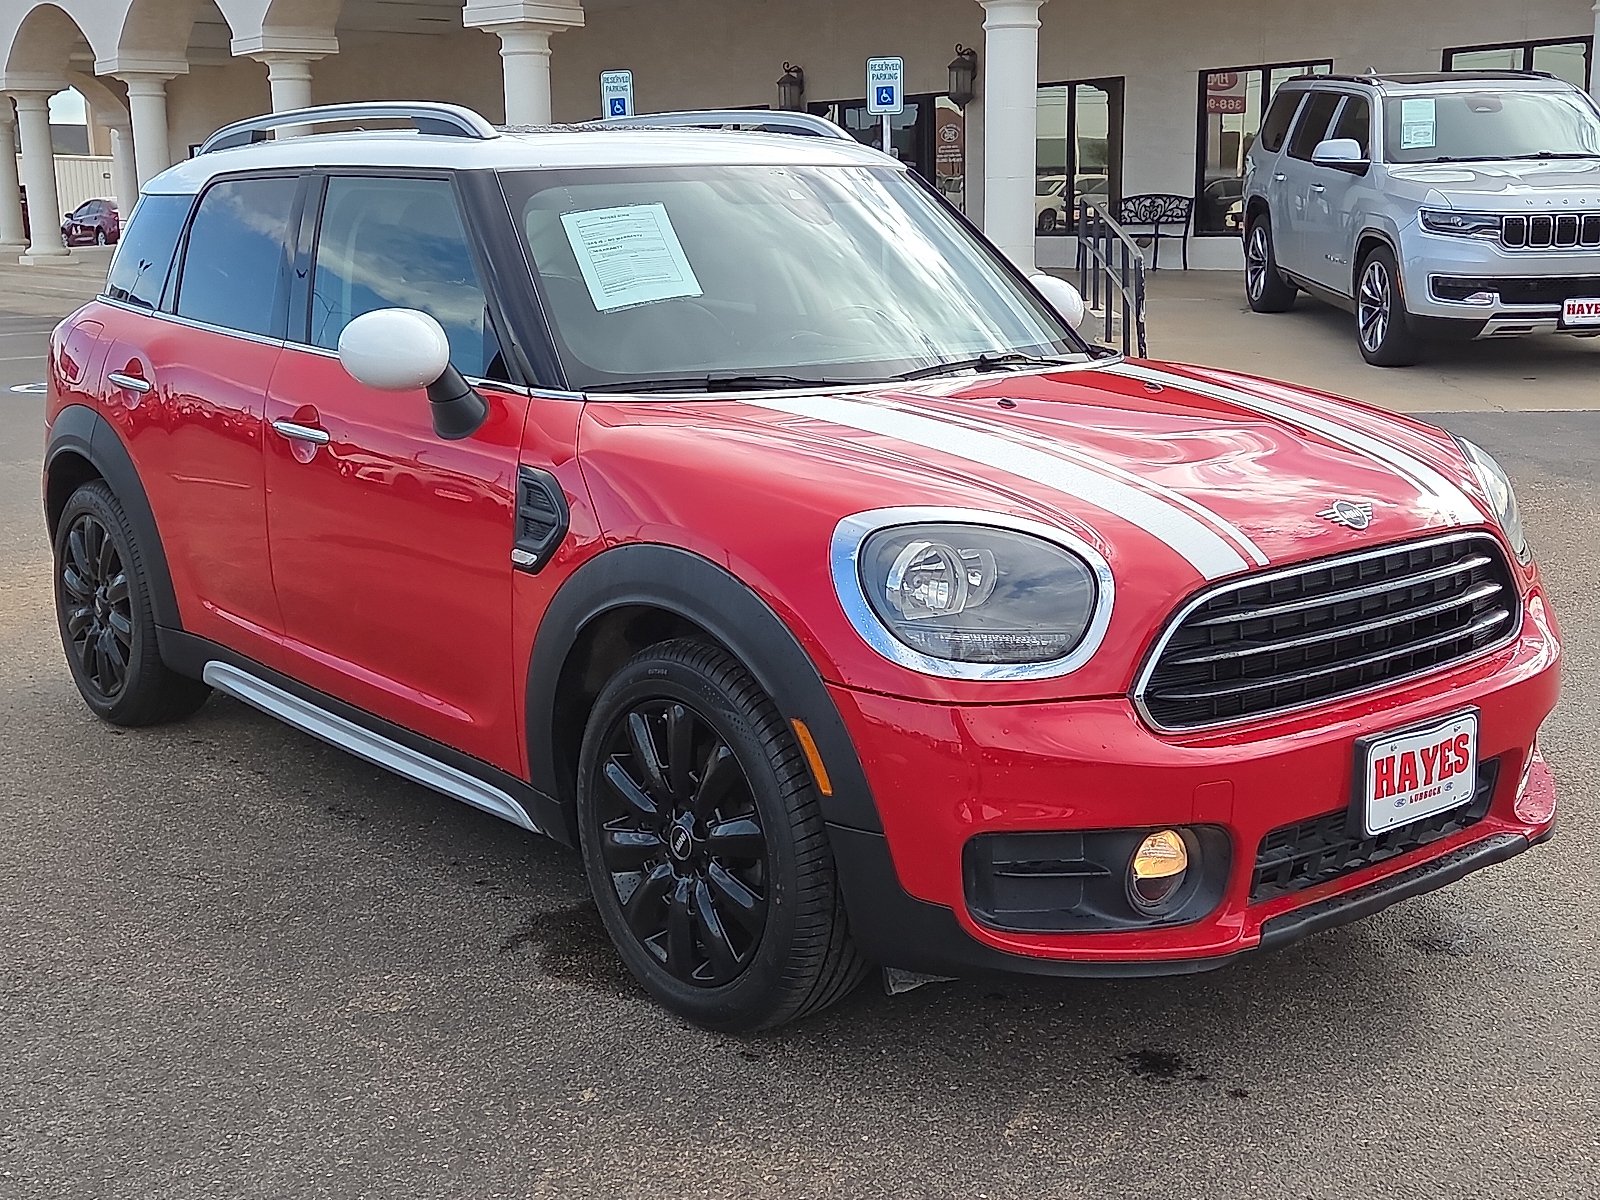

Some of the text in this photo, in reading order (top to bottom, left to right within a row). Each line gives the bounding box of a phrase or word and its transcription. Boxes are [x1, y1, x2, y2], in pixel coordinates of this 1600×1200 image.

[870, 63, 899, 71] RESERVED
[1373, 733, 1470, 801] HAYES
[1409, 785, 1442, 804] LUBBOCK
